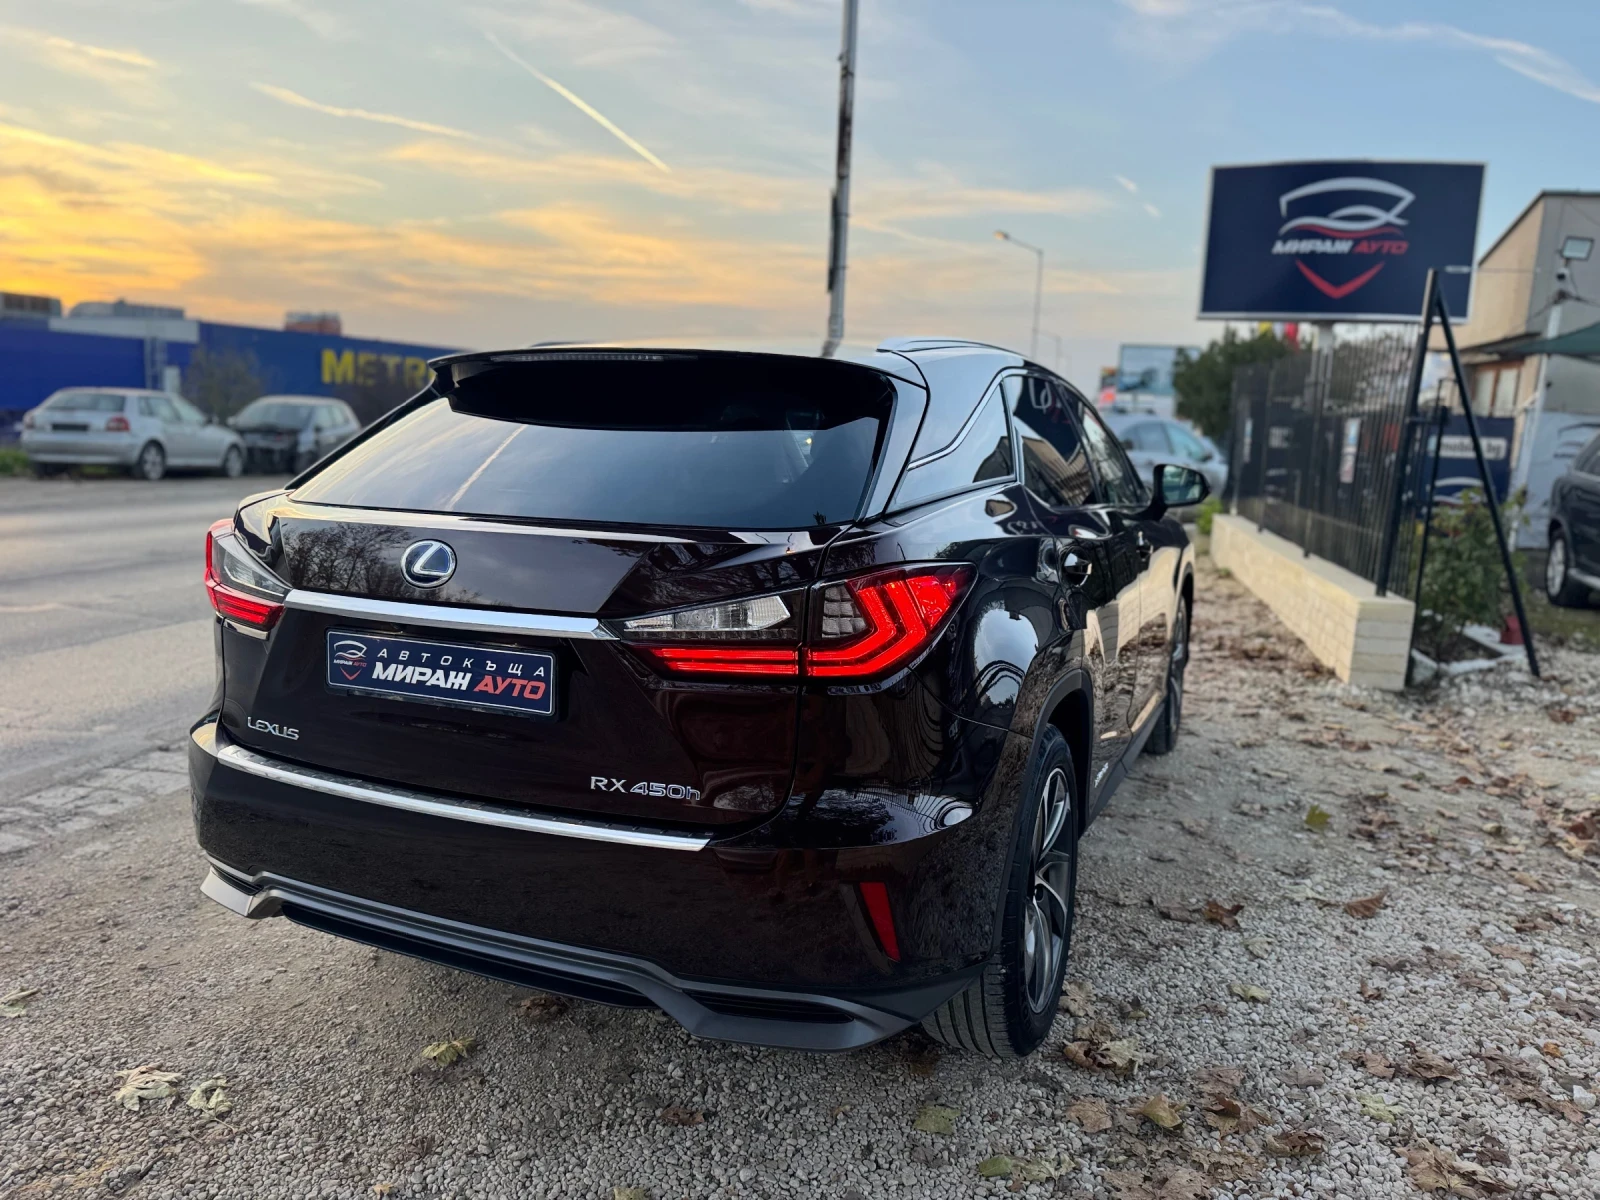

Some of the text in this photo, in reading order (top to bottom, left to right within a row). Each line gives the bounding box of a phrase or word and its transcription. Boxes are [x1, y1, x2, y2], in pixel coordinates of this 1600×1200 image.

[1353, 240, 1409, 255] АУТО
[321, 348, 436, 389] METR
[377, 648, 545, 677] АВТОКЪЩА
[372, 662, 546, 700] МИРАЖ АУТО
[247, 716, 300, 741] LEXUS
[590, 776, 701, 801] RX 450h
